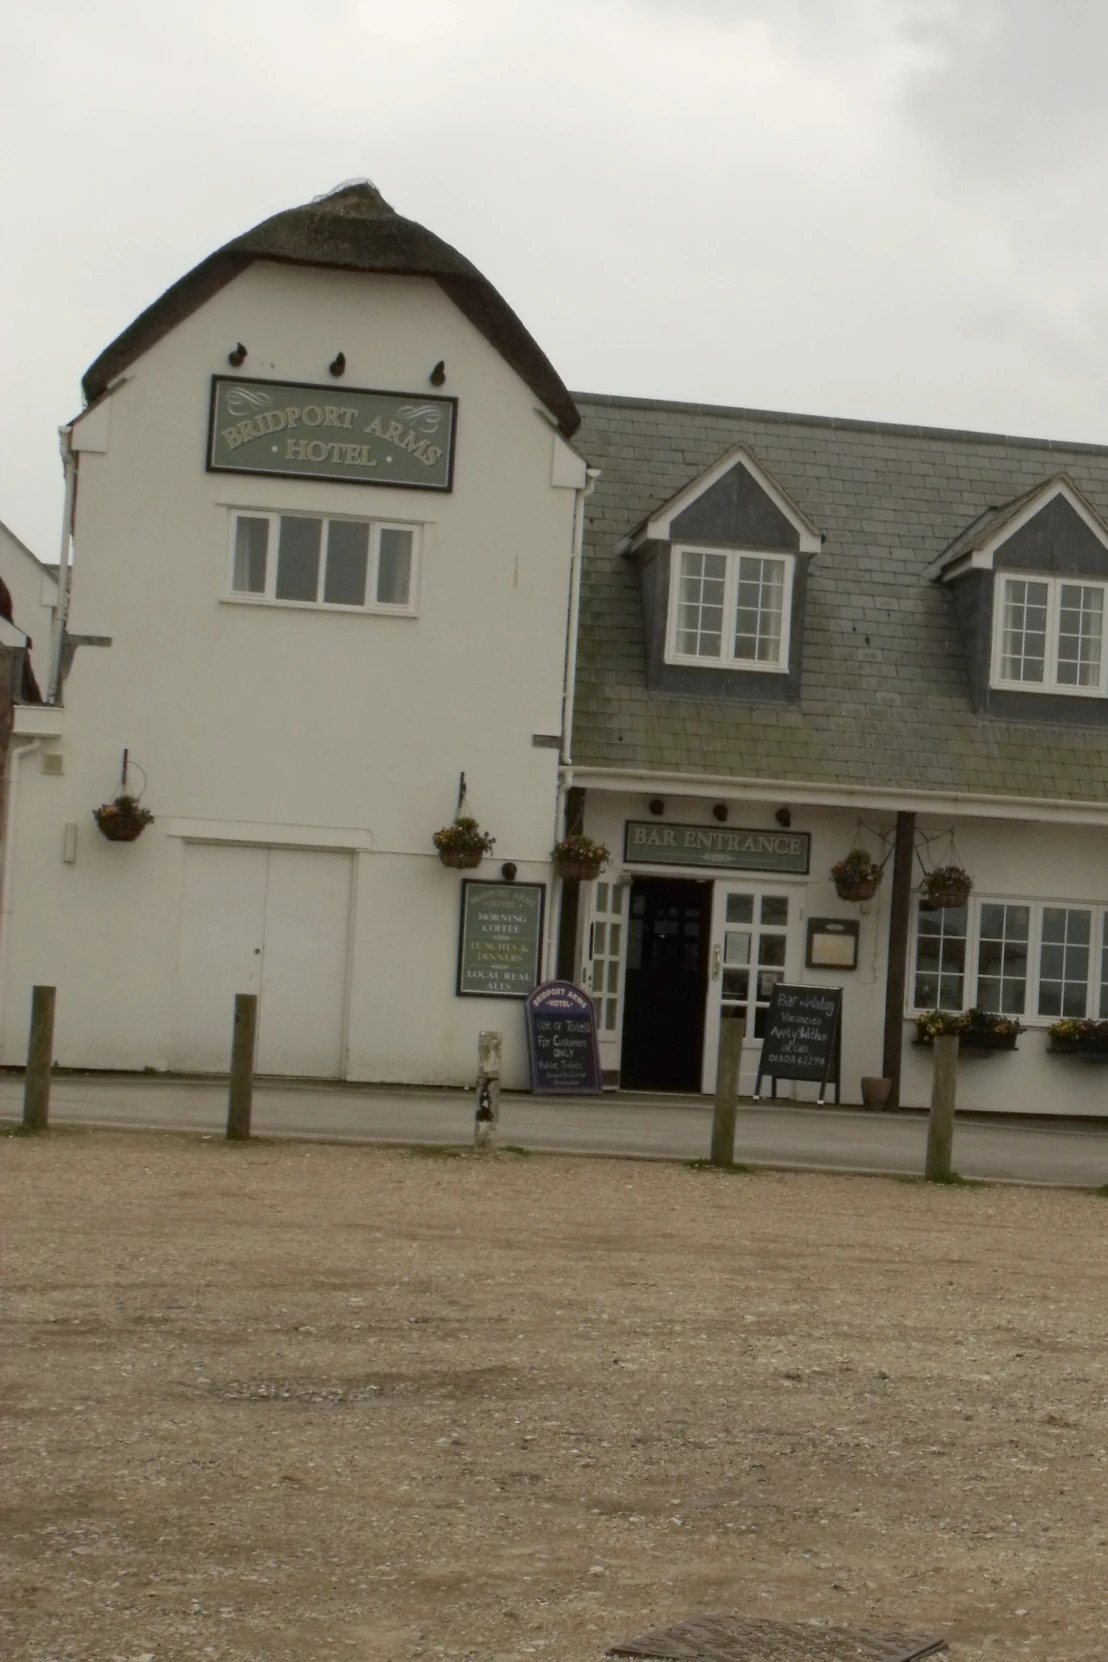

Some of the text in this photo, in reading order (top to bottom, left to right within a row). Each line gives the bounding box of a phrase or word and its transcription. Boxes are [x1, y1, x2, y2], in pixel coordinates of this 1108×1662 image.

[221, 405, 443, 468] BRIDPORT ARMS
[285, 439, 377, 467] HOTEL
[633, 827, 802, 855] BAR ENTRANCE
[477, 912, 527, 923] MORNING
[482, 924, 520, 933] COFFEE
[471, 941, 529, 953] LUNCHES &
[477, 952, 523, 962] DINNERS
[467, 970, 531, 982] LOCAL REAL
[487, 982, 512, 990] ALES
[533, 988, 587, 1009] BRIDPORT ARMS
[549, 1000, 571, 1008] HOTEL
[777, 992, 798, 1007] Bar
[782, 1011, 822, 1026] Vacancies
[770, 1026, 798, 1045] Apply
